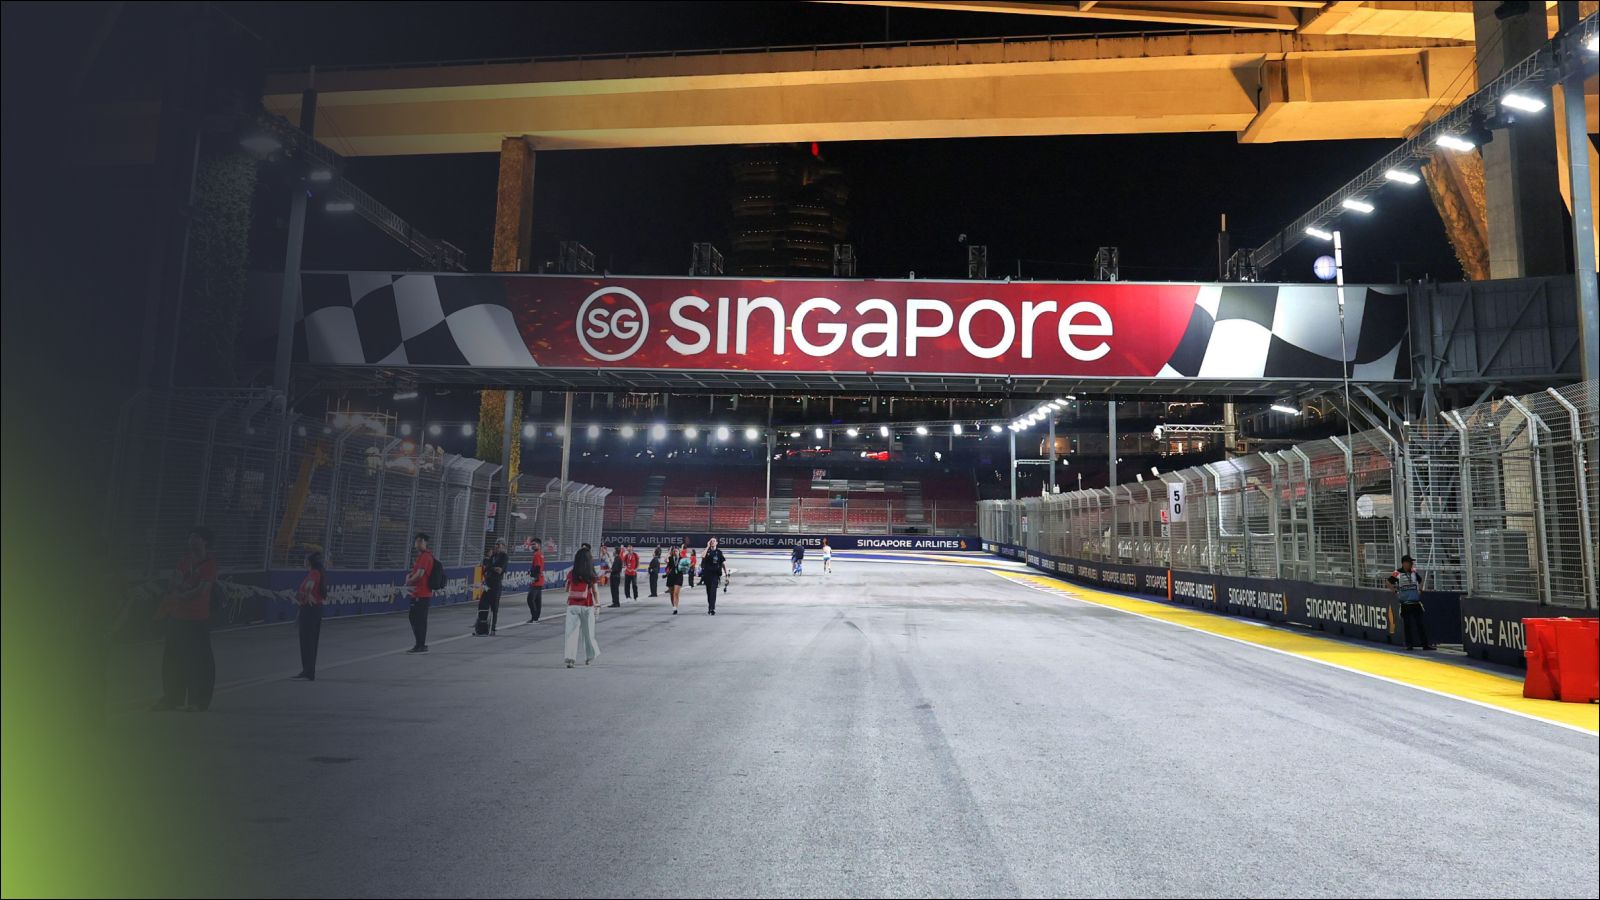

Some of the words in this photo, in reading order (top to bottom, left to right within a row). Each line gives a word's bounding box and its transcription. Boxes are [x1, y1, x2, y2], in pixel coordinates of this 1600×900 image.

[585, 307, 640, 341] SG
[639, 536, 684, 545] AIRLINES
[719, 537, 775, 546] SINGAPORE
[857, 539, 912, 548] SINGAPORE
[915, 540, 959, 548] AIRLINES
[1174, 580, 1195, 598] SINGAPORE
[1195, 583, 1214, 601] AIRLINES
[1228, 587, 1257, 608] SINGAPORE
[1257, 591, 1283, 612] AIRLINES
[1305, 597, 1348, 623] SINGAPORE
[1349, 603, 1388, 630] AIRLINES
[1498, 620, 1528, 650] AIRL
